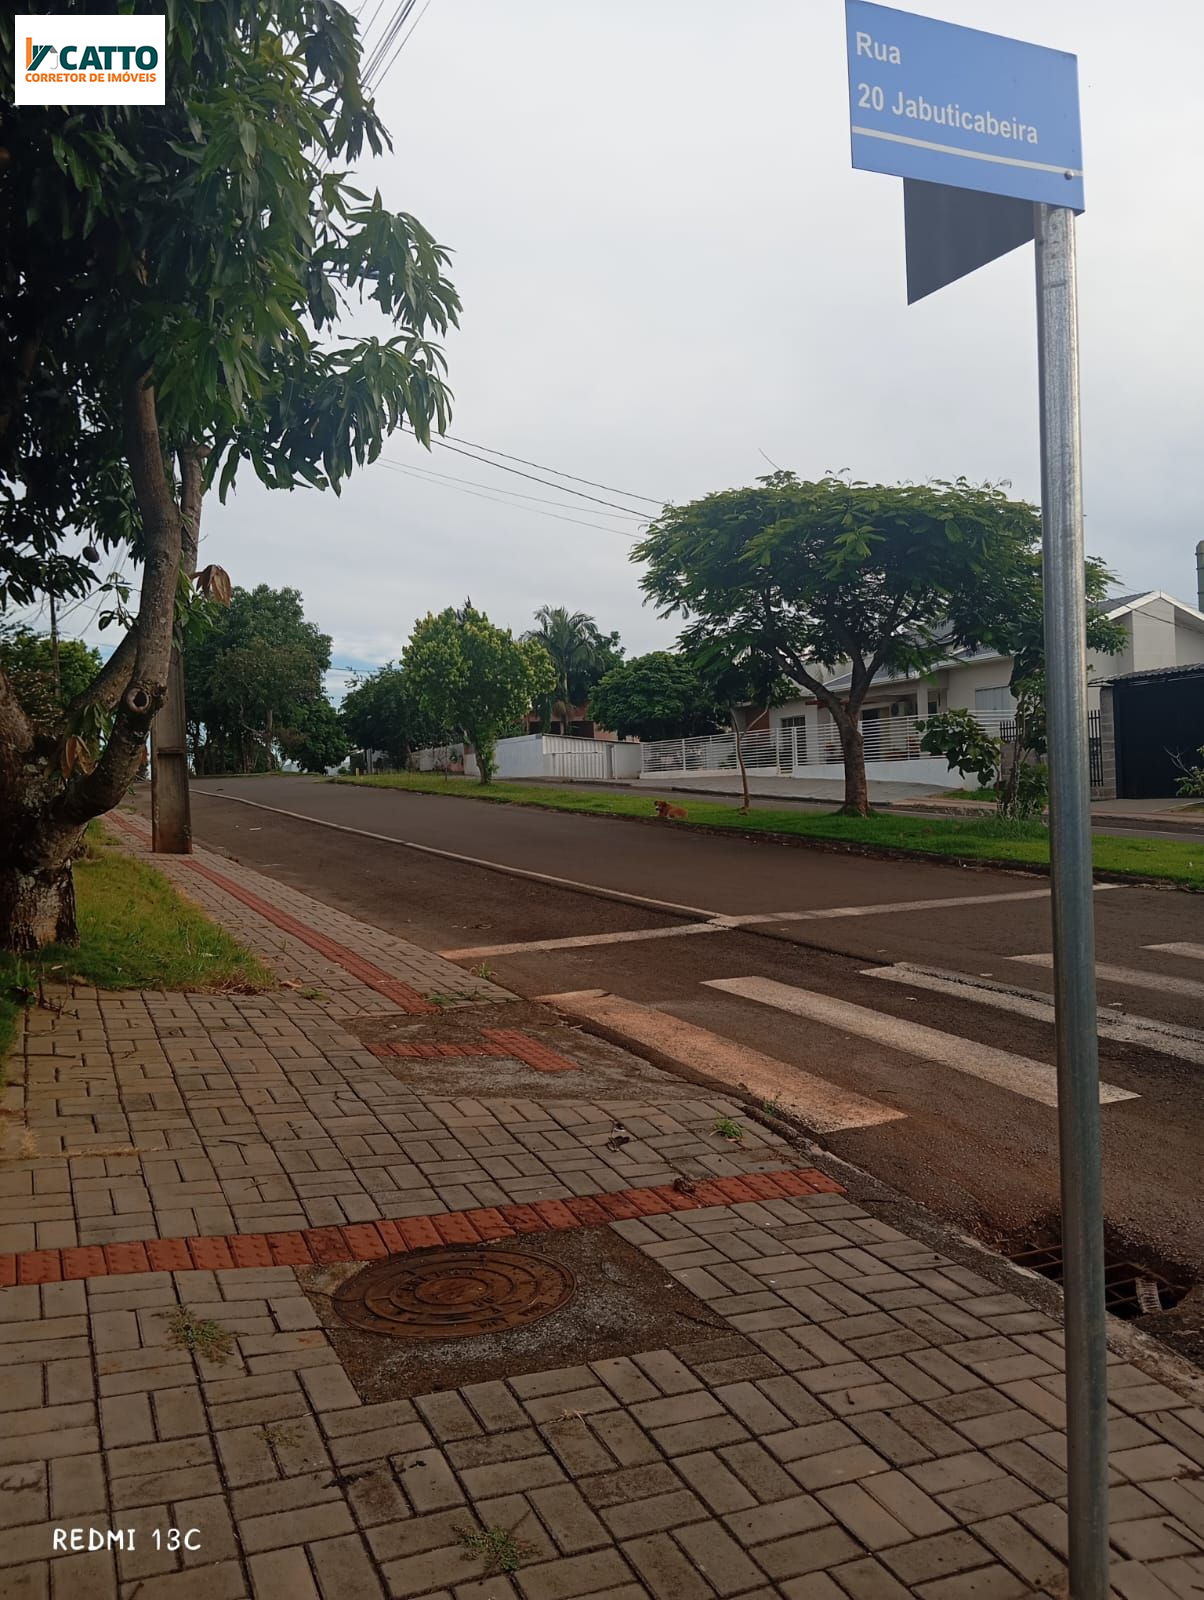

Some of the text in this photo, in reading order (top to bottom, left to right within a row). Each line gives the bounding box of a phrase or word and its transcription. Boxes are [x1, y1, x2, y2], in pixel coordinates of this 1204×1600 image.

[855, 31, 901, 65] Rua
[857, 83, 1039, 145] 20 Jabuticabeira
